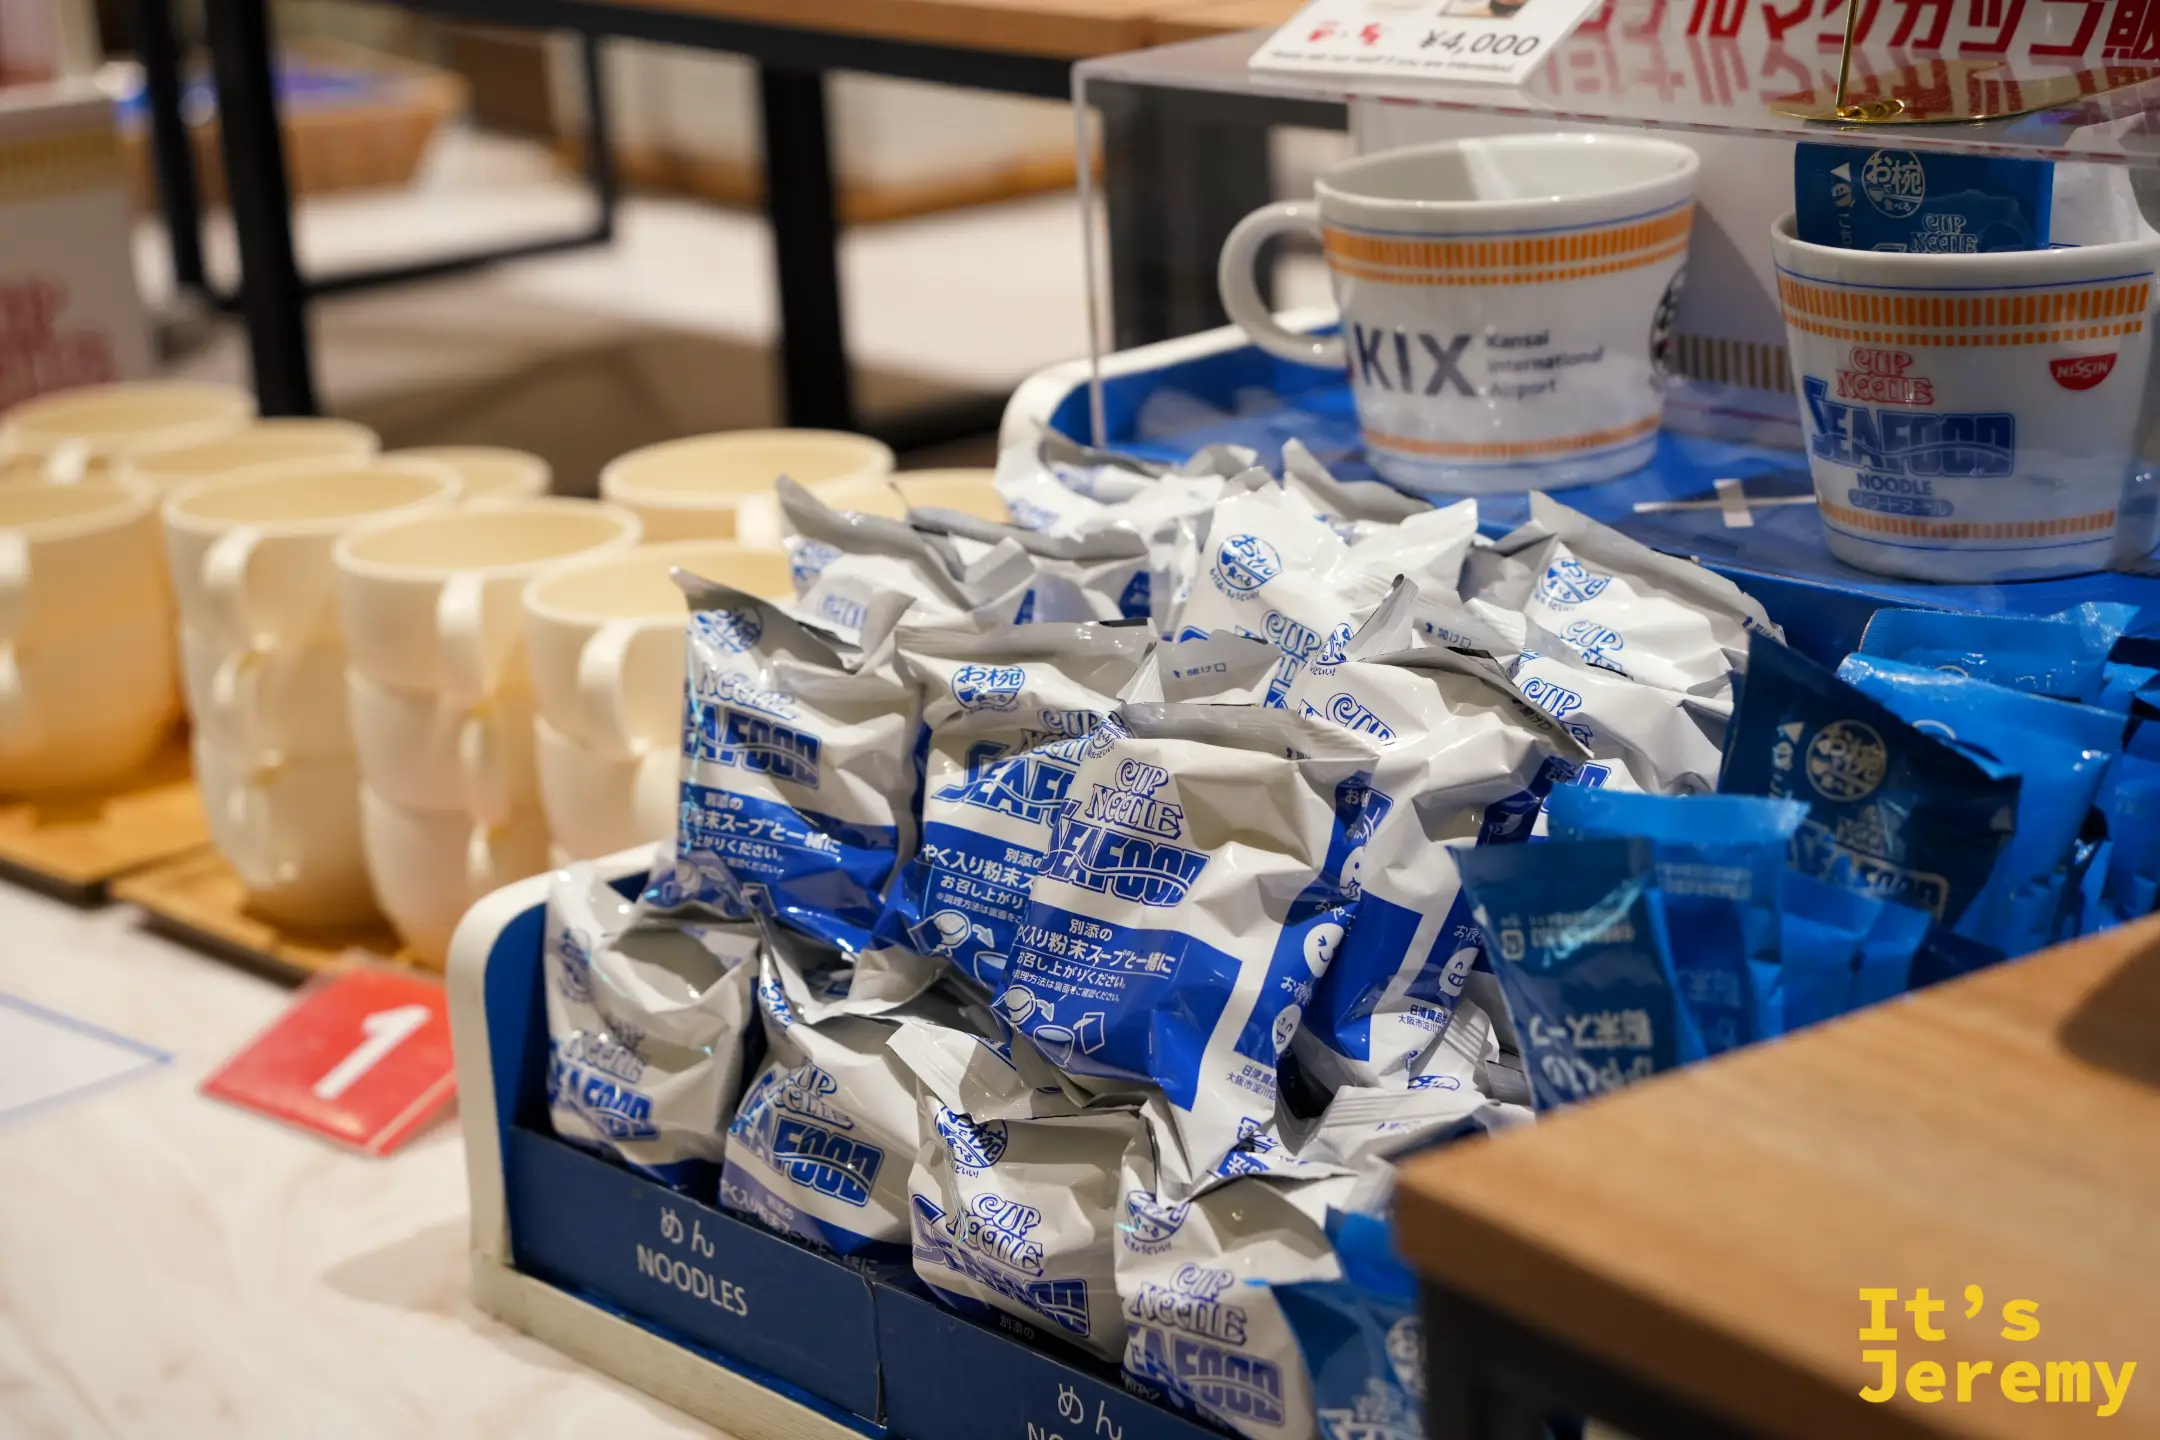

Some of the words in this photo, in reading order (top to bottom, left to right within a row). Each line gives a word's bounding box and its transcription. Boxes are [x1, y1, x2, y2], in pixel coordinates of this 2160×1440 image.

[1418, 29, 1540, 56] ¥4,000
[1922, 214, 1966, 234] CUP
[1486, 330, 1549, 348] Kansai
[1487, 346, 1605, 372] International
[1354, 323, 1477, 397] KIX
[1850, 347, 1914, 376] CUP
[2056, 359, 2109, 378] NISSIN
[1836, 369, 1934, 405] NOODLE
[1803, 375, 2015, 478] SEAFOOD
[1857, 473, 1932, 496] NOODLE
[1260, 610, 1322, 660] CUP
[1561, 619, 1624, 652] CUP
[1519, 677, 1582, 718] CUP
[1037, 708, 1103, 740] CUP
[1115, 758, 1169, 798] CUP
[1085, 783, 1184, 840] NOODLE
[1038, 798, 1211, 908] SEAFOOD
[940, 874, 1024, 910] お召し上がり
[1069, 918, 1112, 941] 別添の
[314, 1004, 432, 1099] 1
[660, 1206, 715, 1258] めん
[970, 1192, 1042, 1239] CUP
[945, 1210, 1044, 1278] NOODLE
[637, 1243, 749, 1317] NOODLES
[1170, 1262, 1235, 1303] CUP
[1130, 1283, 1248, 1346] NOODLE
[1057, 1383, 1123, 1440] めん
